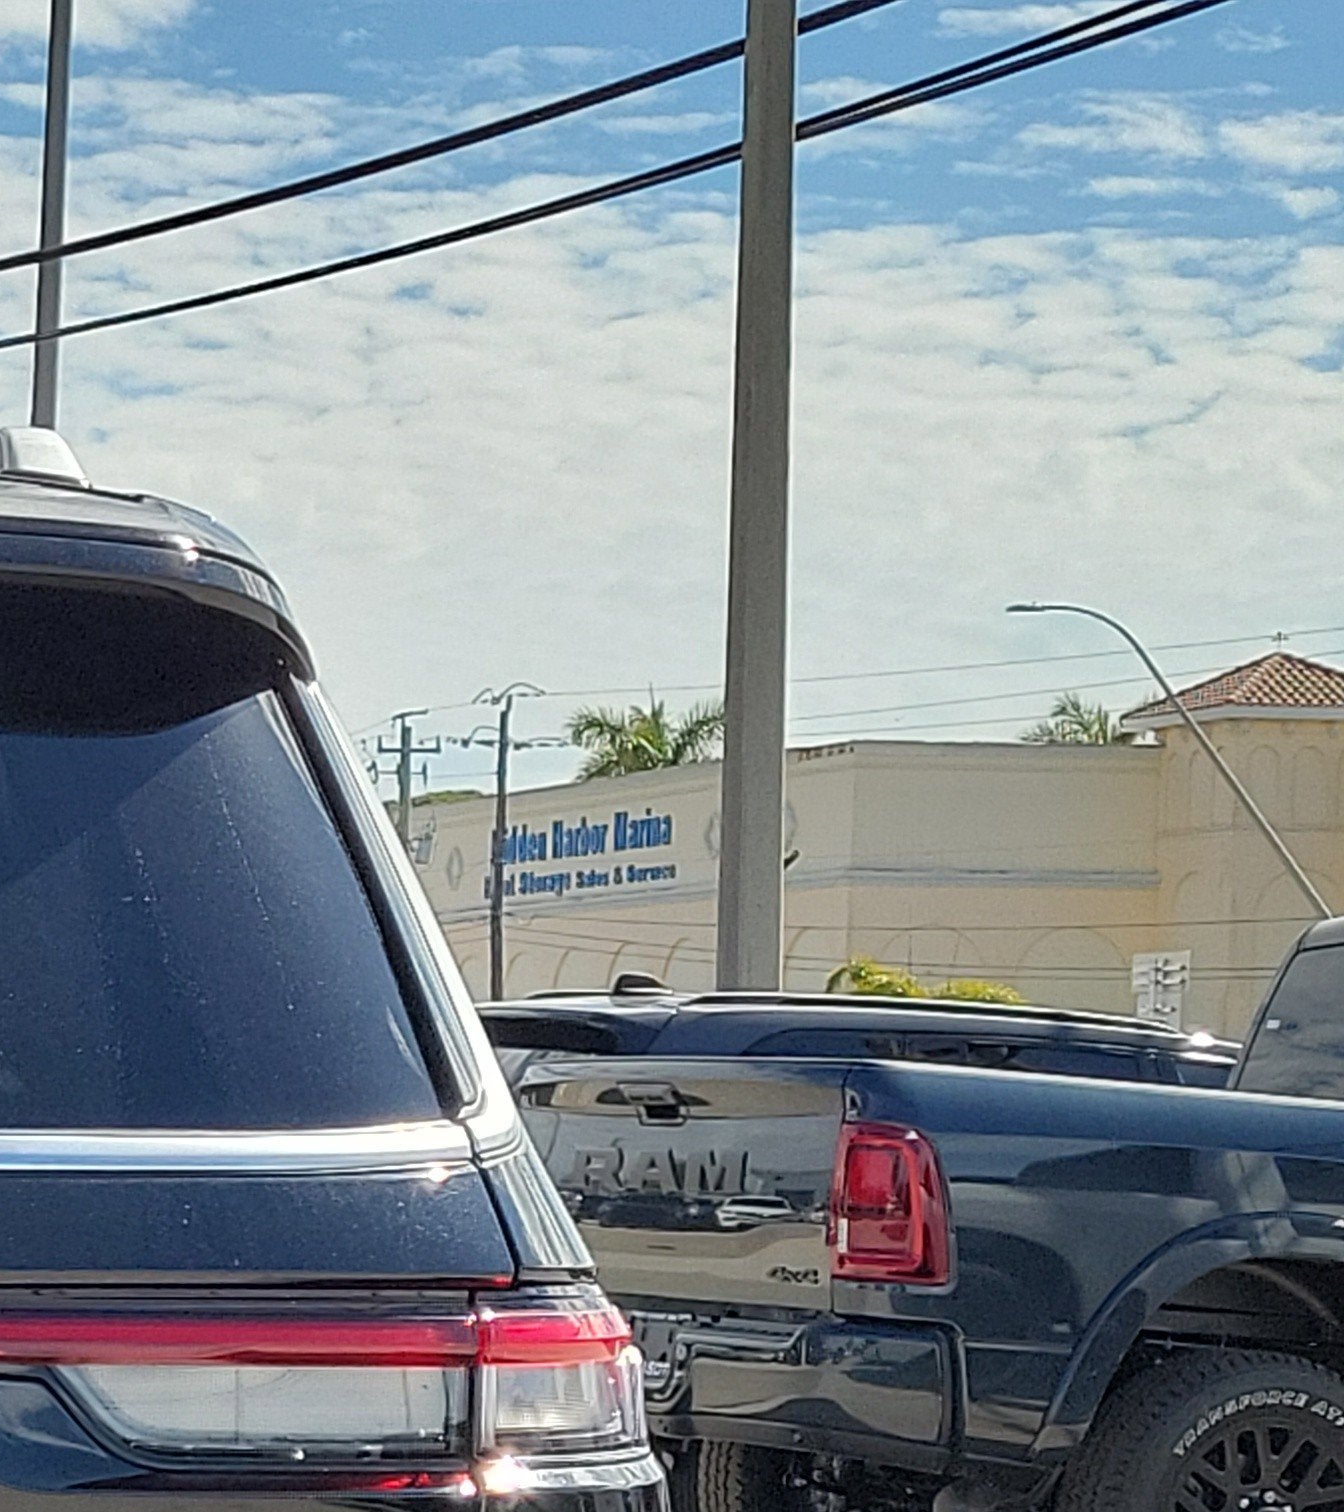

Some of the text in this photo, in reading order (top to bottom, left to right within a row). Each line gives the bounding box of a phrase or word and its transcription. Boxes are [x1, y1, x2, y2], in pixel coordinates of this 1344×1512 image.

[492, 807, 672, 865] olden Harbor Marina
[613, 865, 623, 885] &
[568, 1146, 749, 1196] RAM
[766, 1265, 821, 1286] 4x4
[1173, 1389, 1310, 1456] TRANSFORCE
